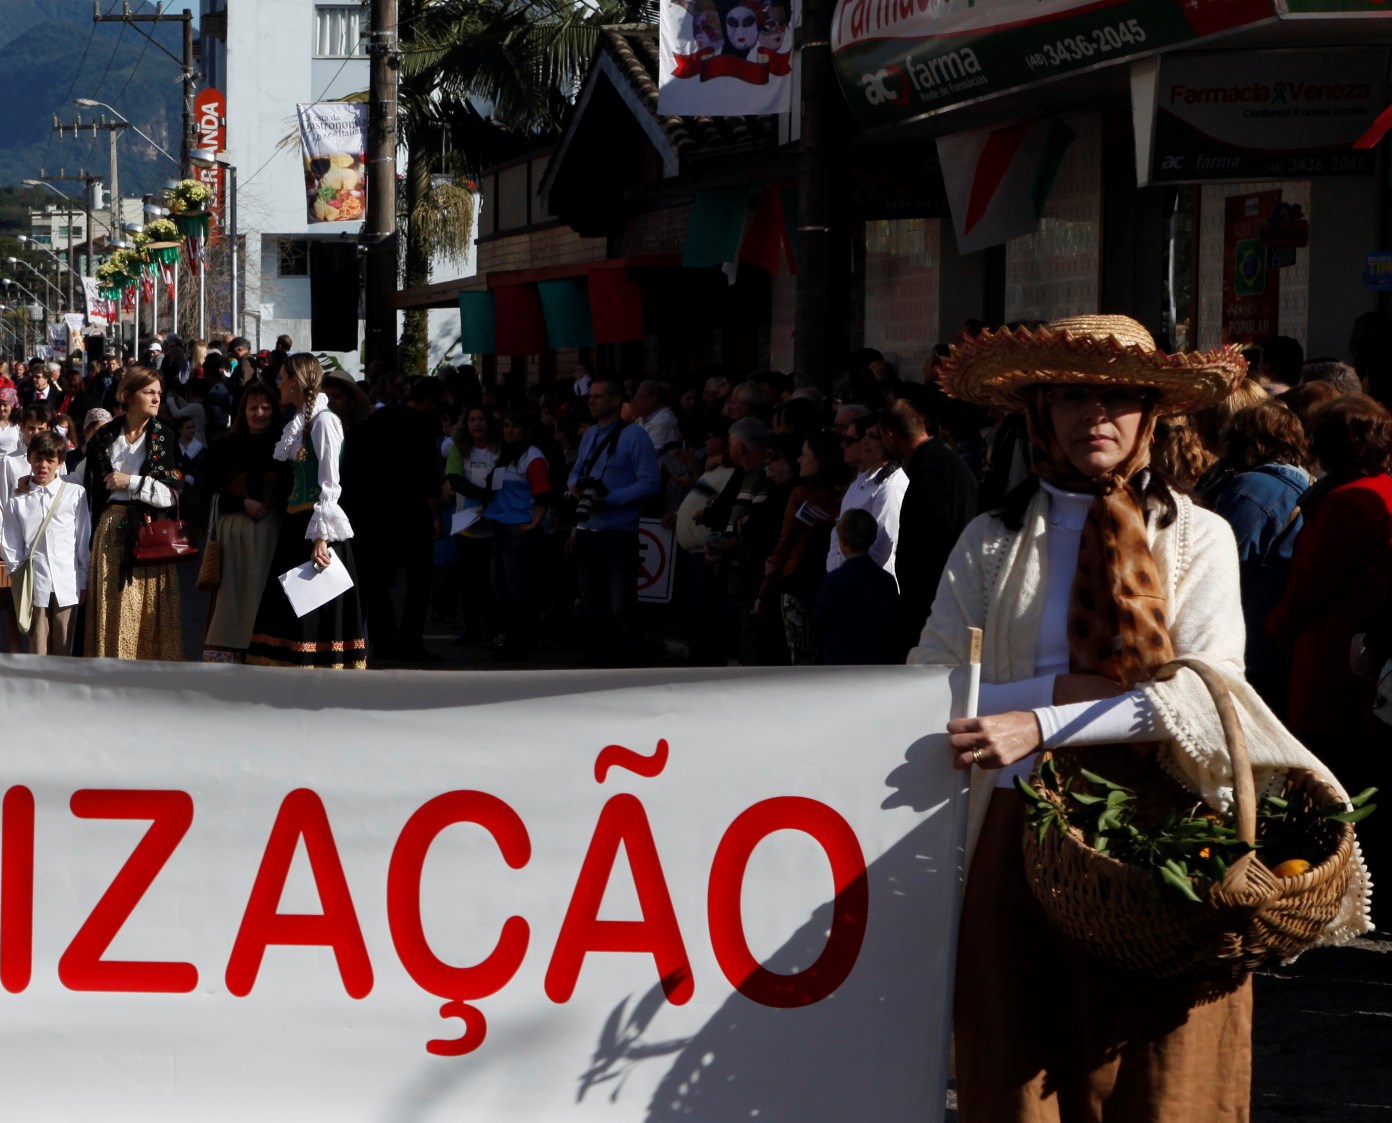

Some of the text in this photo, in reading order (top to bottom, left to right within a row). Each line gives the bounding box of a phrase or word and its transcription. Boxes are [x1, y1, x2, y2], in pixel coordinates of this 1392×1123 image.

[1025, 18, 1146, 70] (48) 3436-2045
[906, 47, 982, 91] farma
[1170, 82, 1371, 104] Farmácia Veneza
[1195, 153, 1241, 169] farma
[1288, 157, 1366, 173] 3436-2045
[1228, 319, 1270, 336] POPULAR
